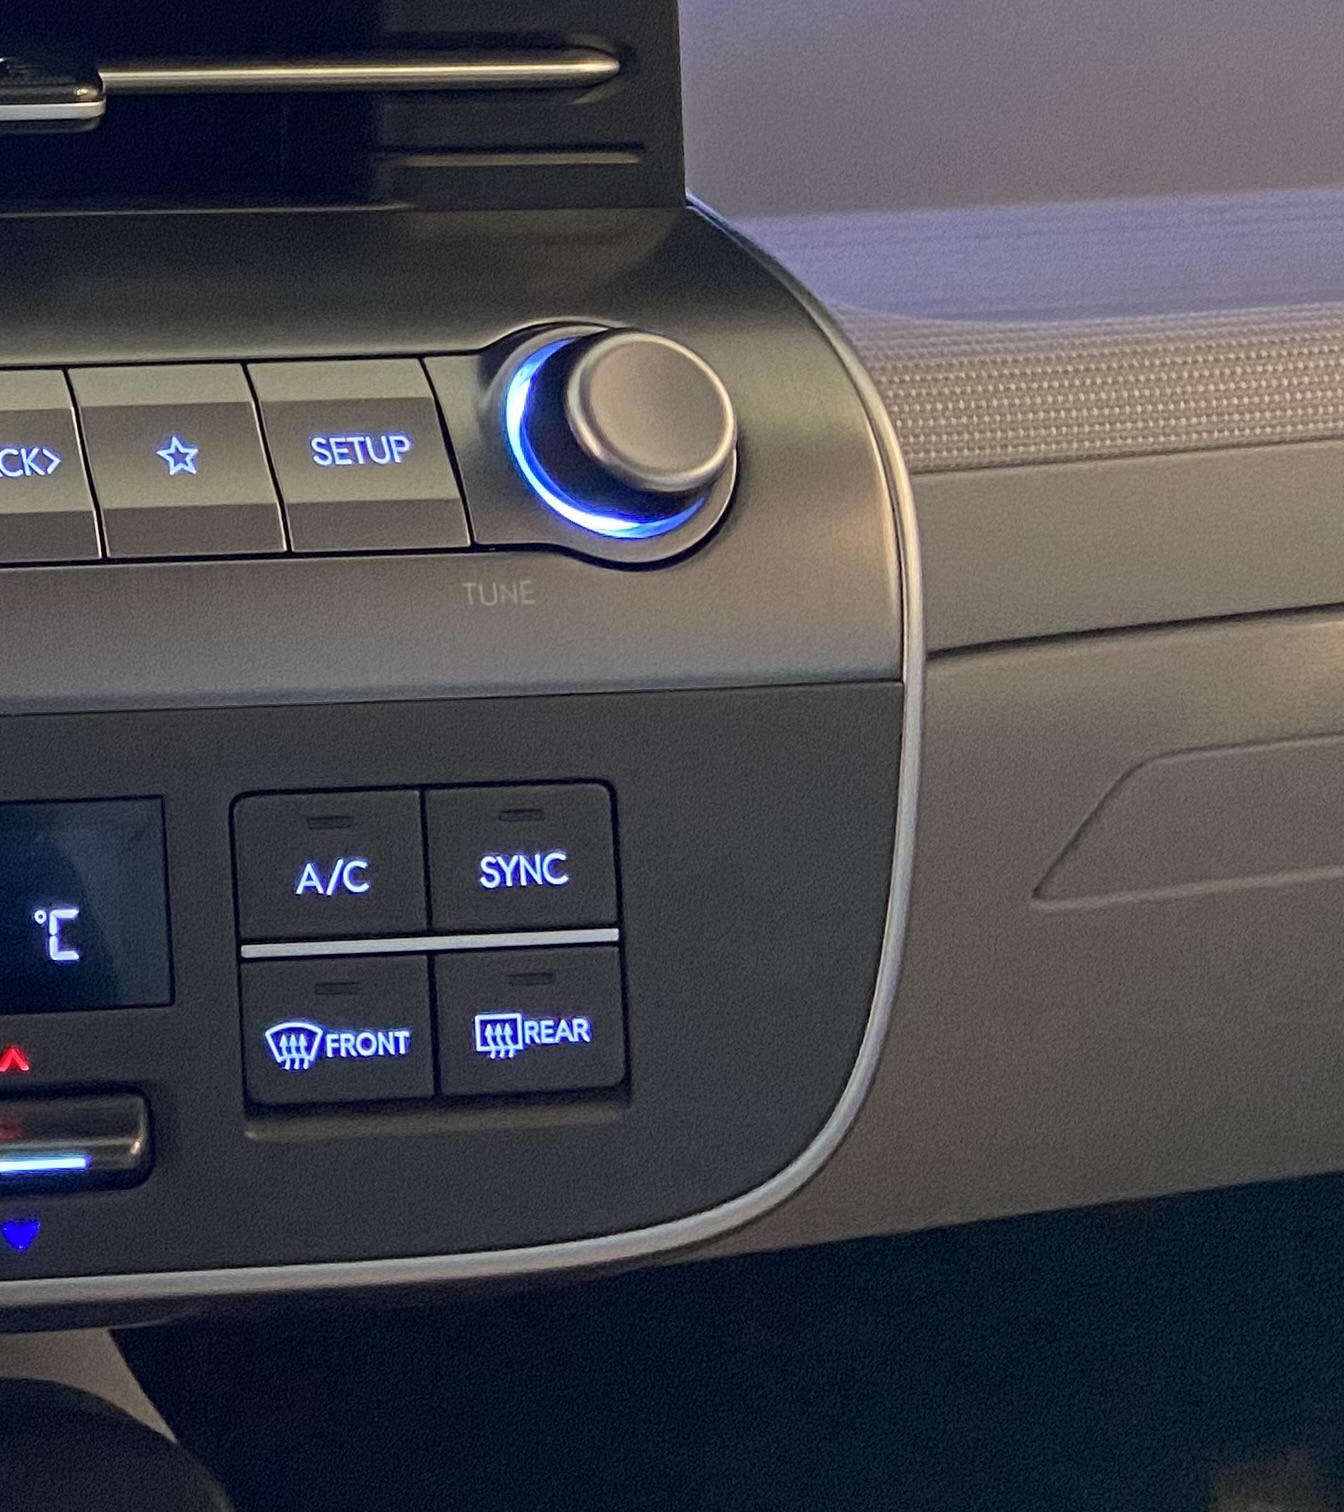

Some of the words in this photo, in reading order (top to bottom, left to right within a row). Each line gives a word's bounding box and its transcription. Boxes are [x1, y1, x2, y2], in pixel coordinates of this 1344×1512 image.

[311, 432, 413, 466] SETUP
[461, 580, 536, 607] TUNE
[295, 857, 370, 896] A/C
[479, 849, 570, 889] SYNC
[323, 1025, 411, 1058] FRONT
[522, 1015, 592, 1050] REAR
